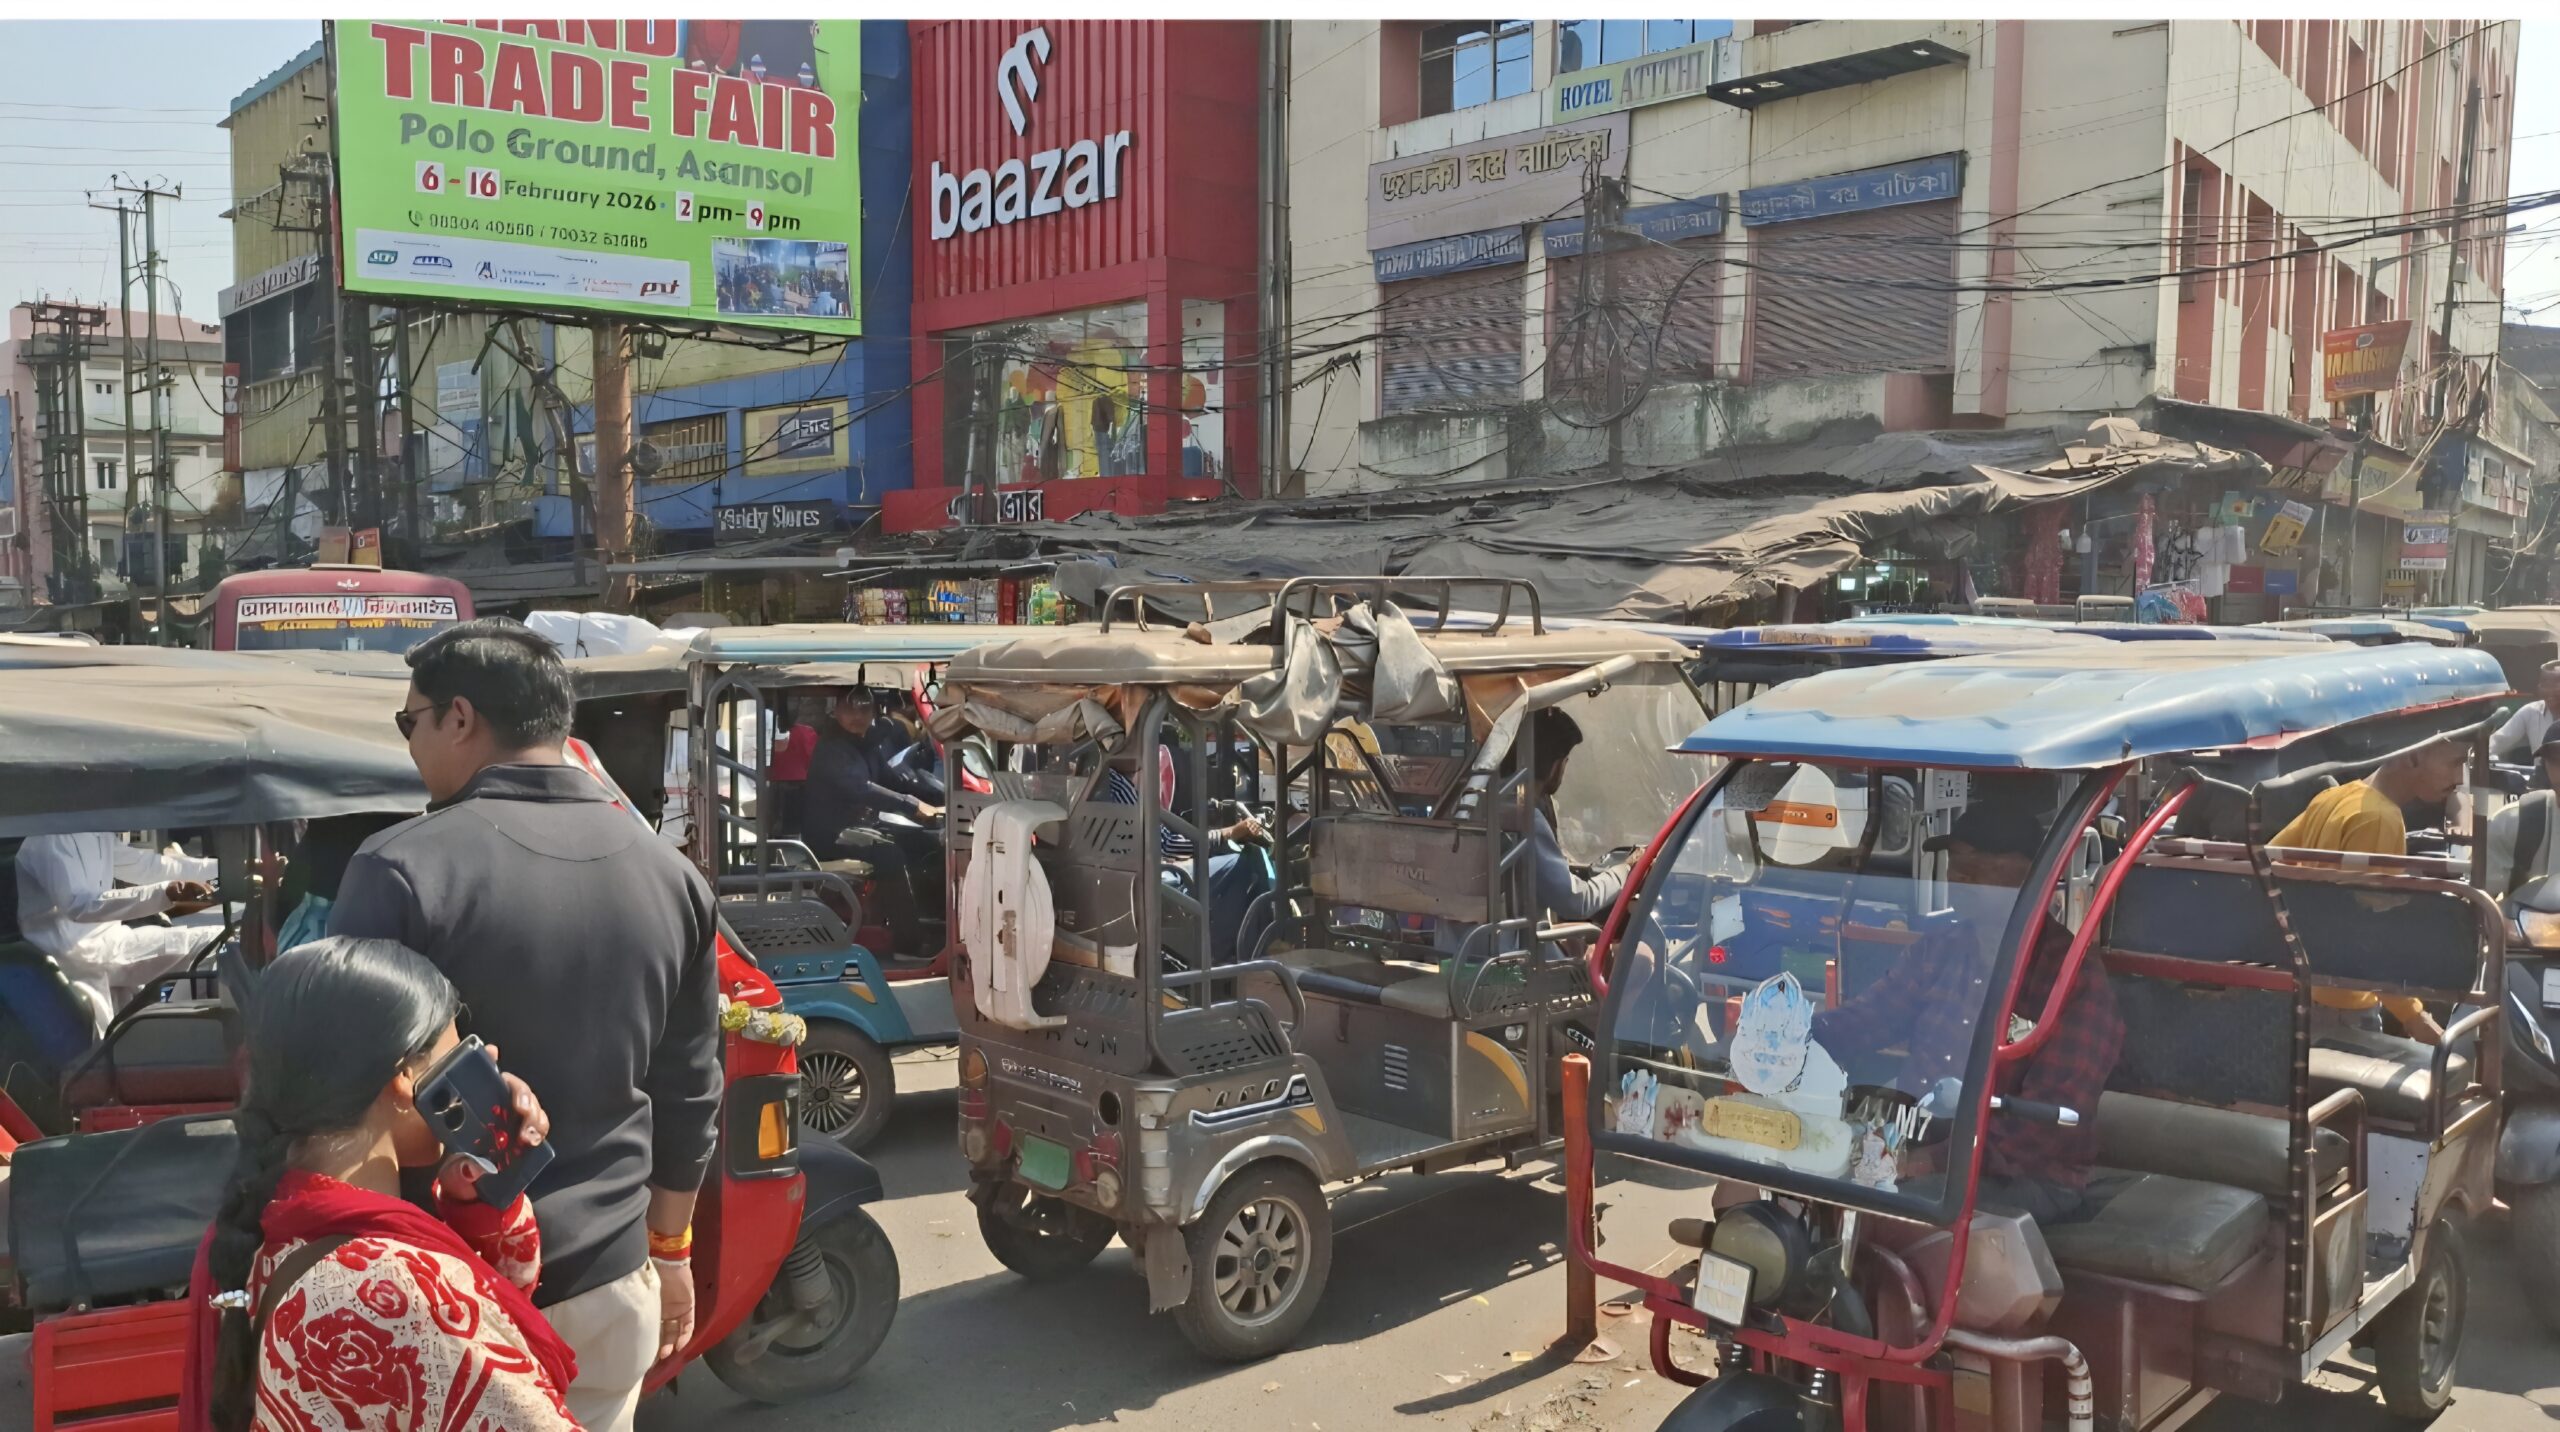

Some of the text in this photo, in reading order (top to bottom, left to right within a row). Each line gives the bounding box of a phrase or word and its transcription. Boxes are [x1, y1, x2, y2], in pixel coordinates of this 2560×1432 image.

[372, 23, 836, 159] TRADE FAIR
[1560, 79, 1613, 112] HOTEL
[401, 113, 814, 197] Polo Ground, Asansol
[931, 130, 1130, 241] baazar
[421, 165, 440, 191] 6
[469, 171, 498, 197] 16
[504, 180, 600, 209] February
[606, 192, 657, 212] 2026
[680, 199, 691, 217] 2
[698, 205, 732, 222] pm
[750, 208, 763, 226] 9
[768, 215, 801, 231] pm
